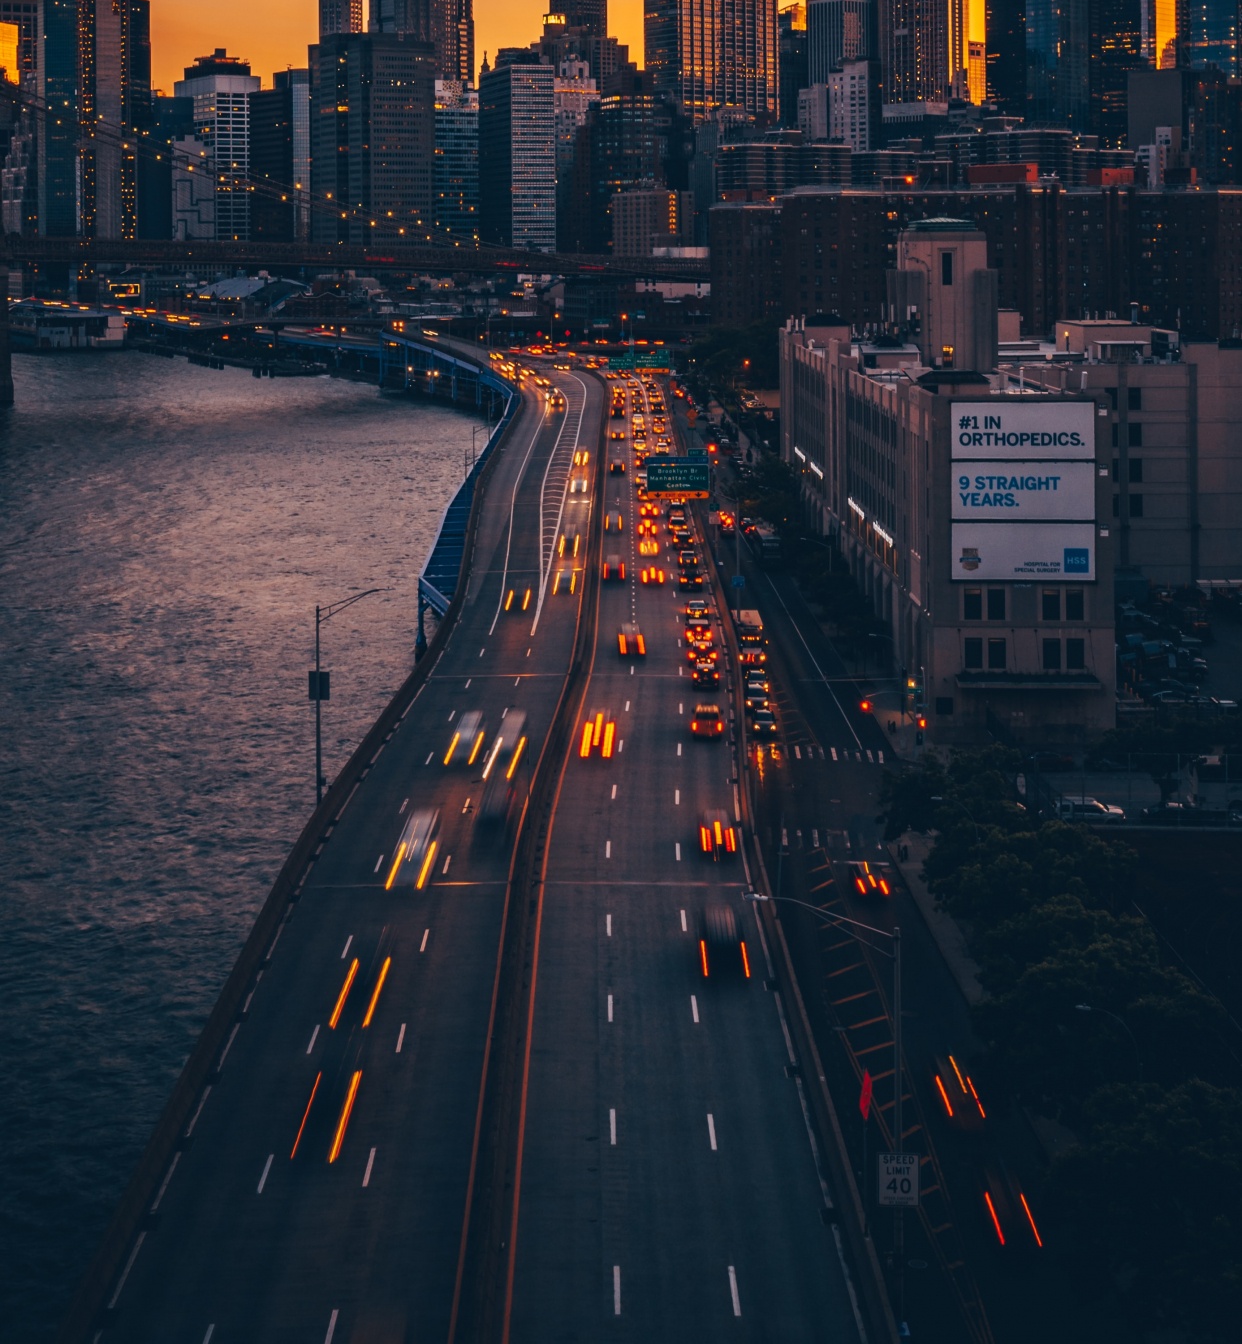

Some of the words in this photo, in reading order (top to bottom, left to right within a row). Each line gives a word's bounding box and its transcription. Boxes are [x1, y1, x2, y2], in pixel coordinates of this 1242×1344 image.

[959, 416, 979, 429] #1
[984, 416, 1001, 429] IN
[959, 433, 1085, 446] ORTHOPEDICS.
[959, 476, 970, 490] 9
[975, 476, 1061, 490] STRAIGHT
[959, 493, 1020, 507] YEARS.
[883, 1156, 915, 1164] SPEED
[886, 1167, 911, 1175] LIMIT
[886, 1178, 911, 1194] 40
